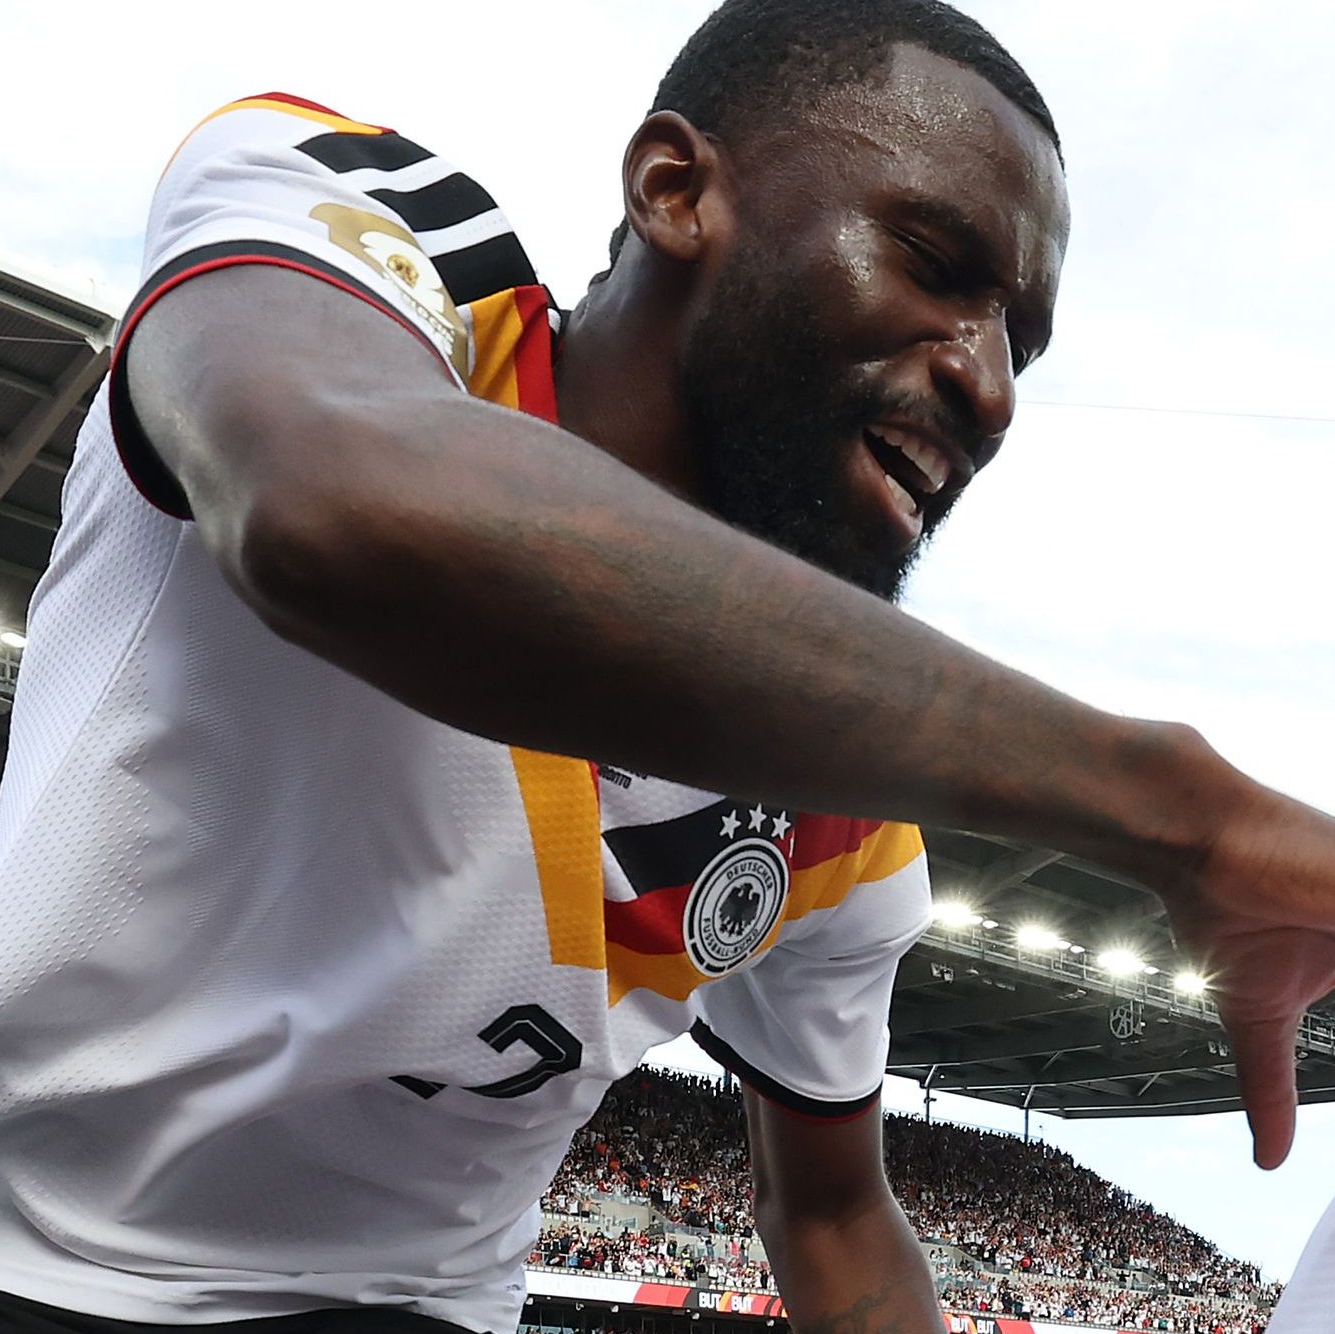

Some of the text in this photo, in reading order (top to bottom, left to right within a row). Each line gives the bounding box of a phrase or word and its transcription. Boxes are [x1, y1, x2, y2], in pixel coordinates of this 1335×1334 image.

[726, 861, 774, 891] DEUTSCHER
[698, 1291, 754, 1312] BUT BUT
[951, 1316, 995, 1334] BUT BUT
